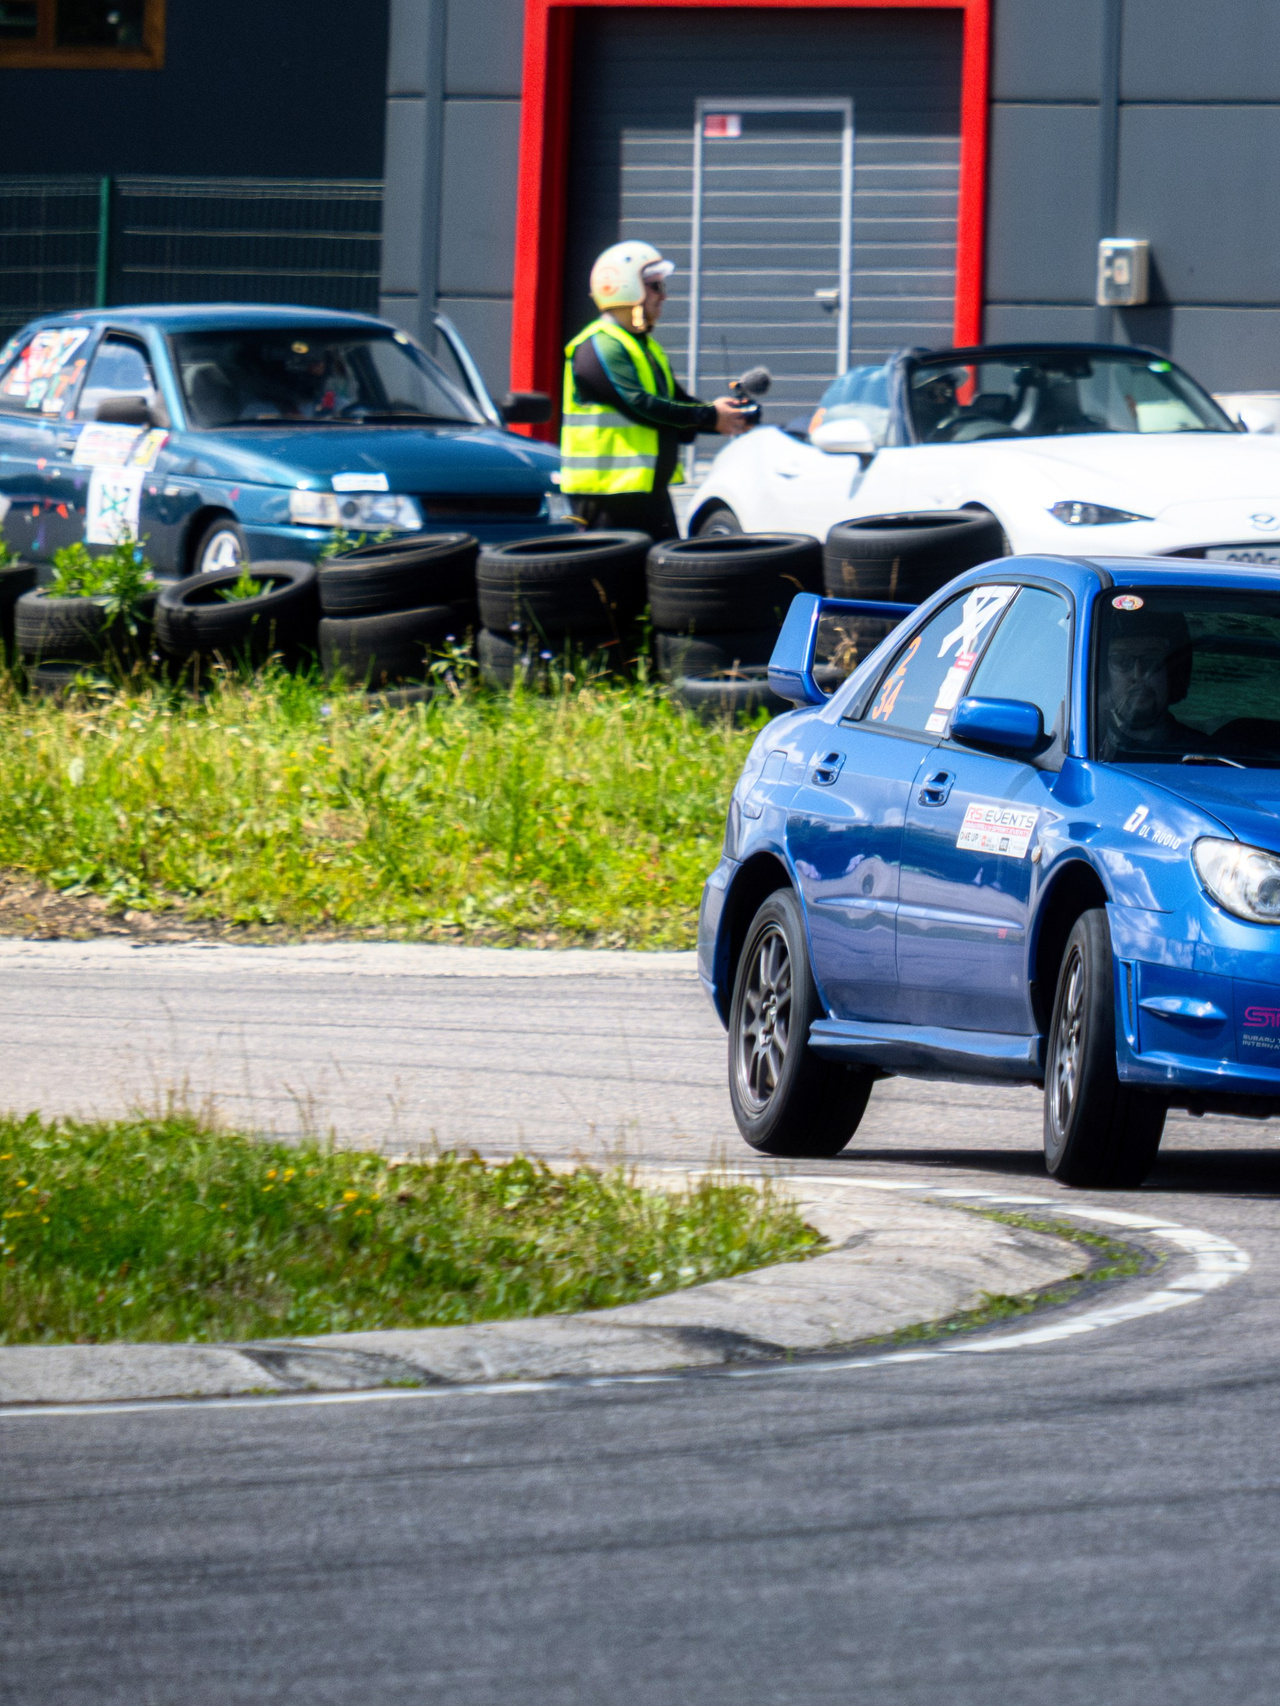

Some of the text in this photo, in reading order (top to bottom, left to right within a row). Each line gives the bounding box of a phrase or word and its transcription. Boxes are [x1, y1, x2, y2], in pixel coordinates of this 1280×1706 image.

[966, 806, 1036, 828] RS EVENTS
[1138, 824, 1182, 850] DL AUDIO
[1242, 1034, 1276, 1044] SUBARU
